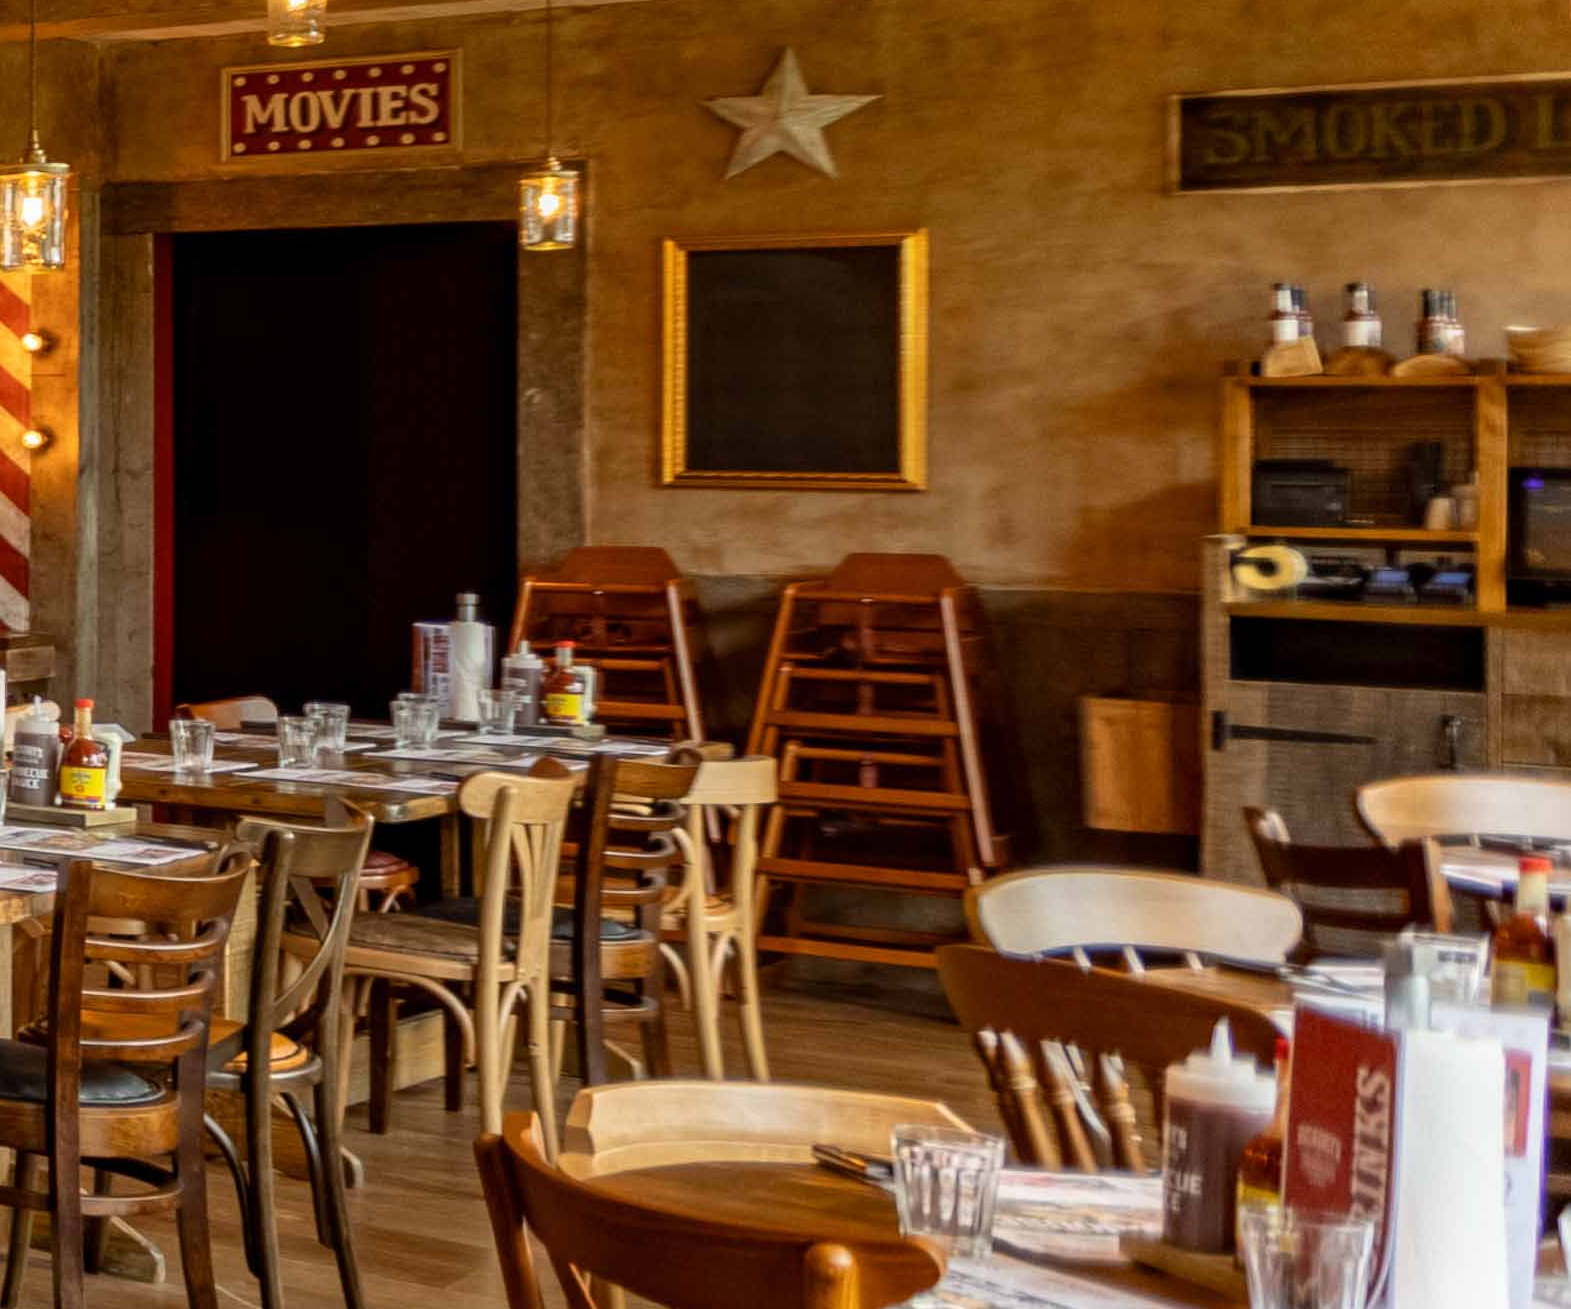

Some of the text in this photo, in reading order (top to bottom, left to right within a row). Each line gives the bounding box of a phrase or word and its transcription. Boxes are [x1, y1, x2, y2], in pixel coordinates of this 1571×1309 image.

[240, 82, 440, 134] MOVIES
[1201, 94, 1509, 165] SMOKED
[1350, 1065, 1390, 1224] RINKS
